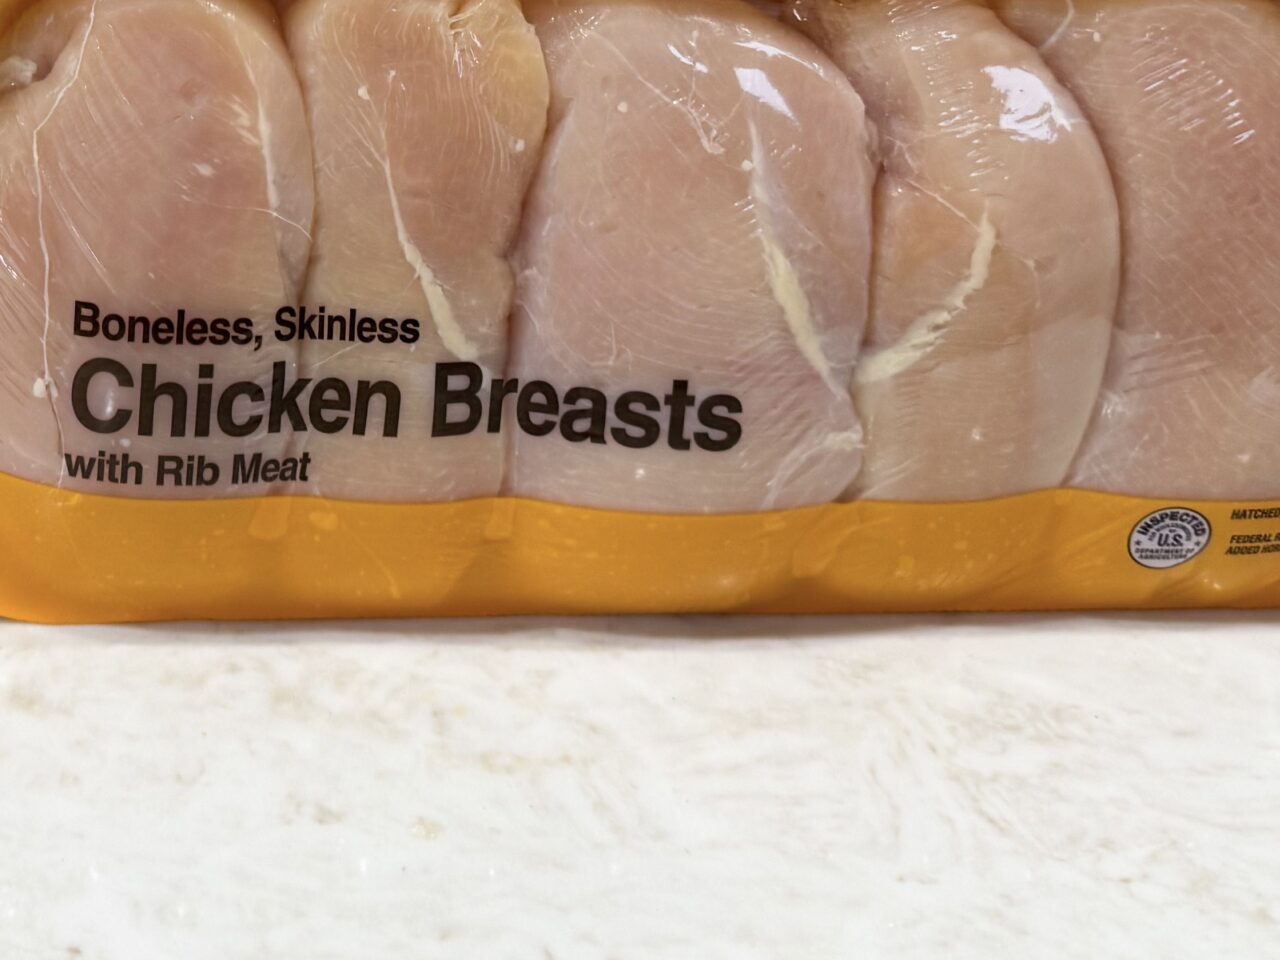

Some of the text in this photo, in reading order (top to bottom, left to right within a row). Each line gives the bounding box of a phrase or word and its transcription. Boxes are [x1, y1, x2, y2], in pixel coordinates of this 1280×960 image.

[73, 300, 420, 351] Boneless, Skinless
[71, 357, 743, 452] Chicken Breasts
[64, 451, 311, 486] with Rib Meat
[1136, 511, 1206, 537] INSPECTED
[1157, 532, 1184, 547] U.S.
[1225, 545, 1260, 555] ADDED
[1230, 533, 1271, 544] FEDERAL
